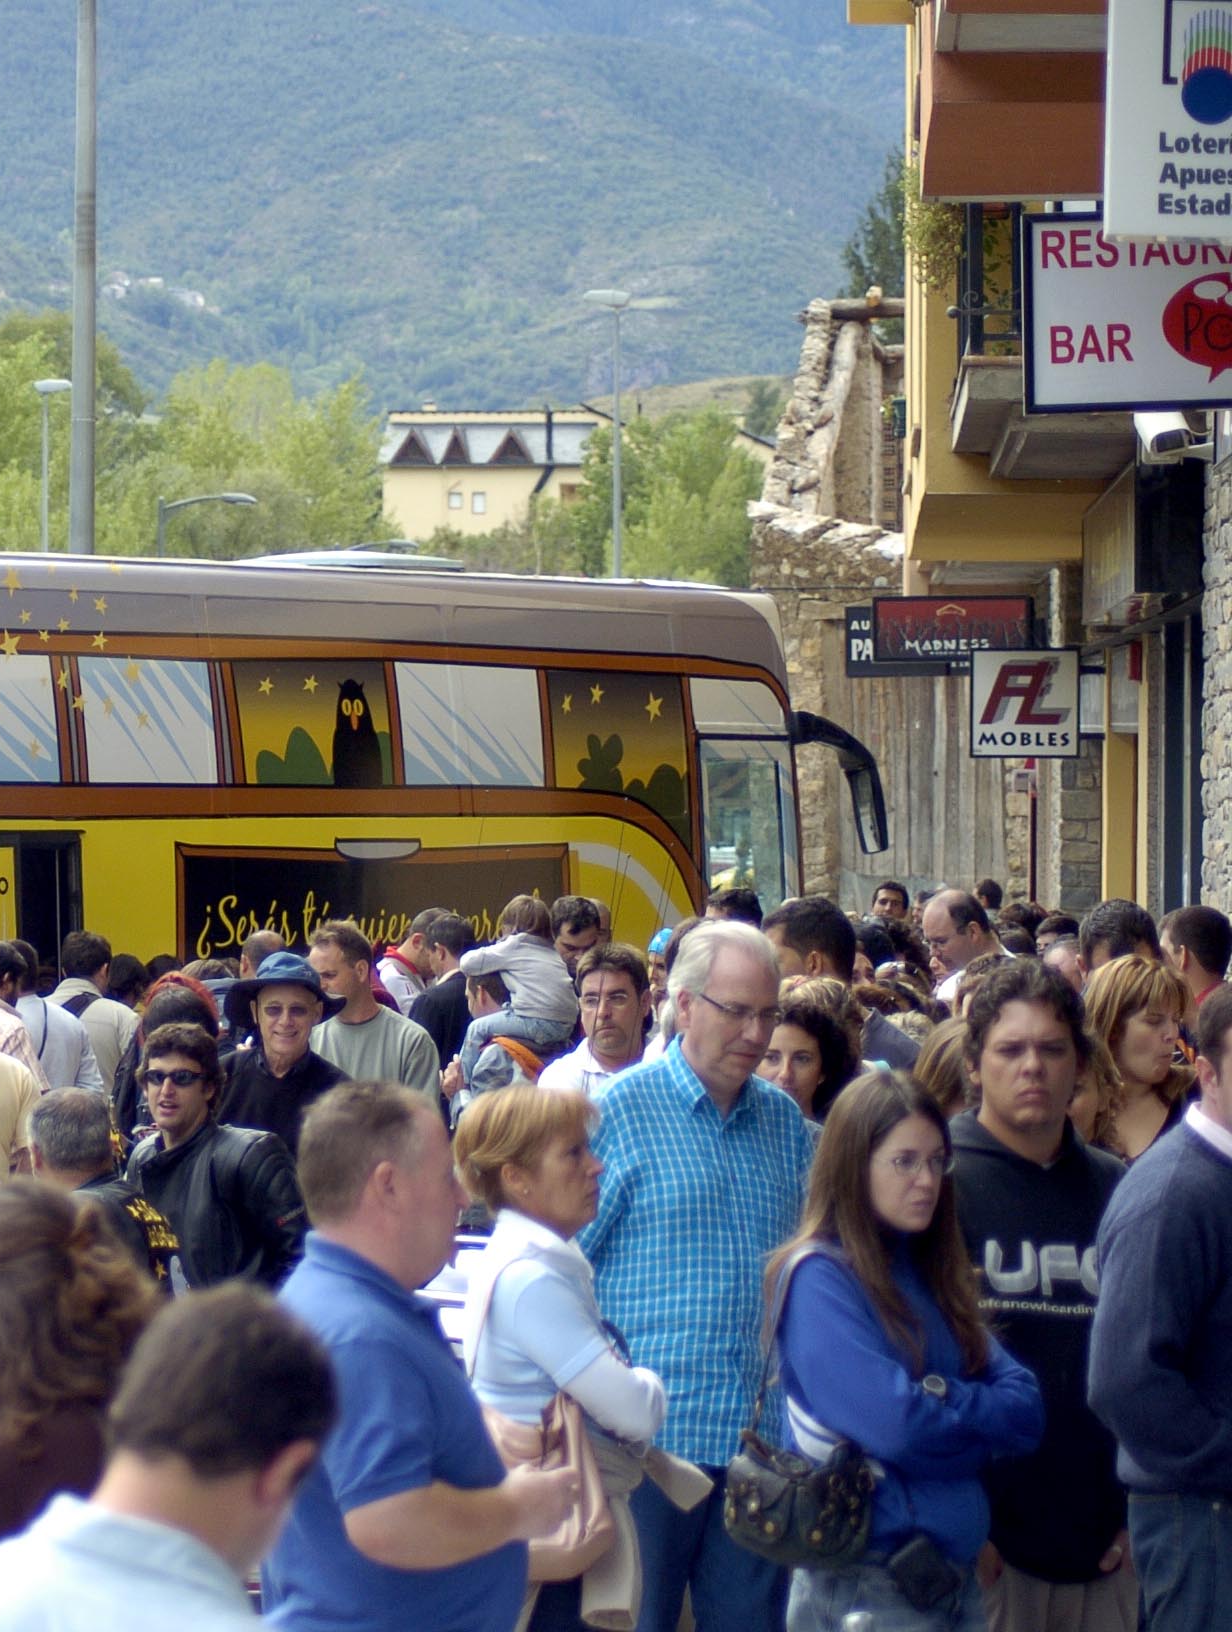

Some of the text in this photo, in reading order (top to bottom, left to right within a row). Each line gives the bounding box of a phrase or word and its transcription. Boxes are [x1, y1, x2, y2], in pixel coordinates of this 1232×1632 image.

[1049, 323, 1134, 365] BAR
[905, 638, 990, 656] MADNESS
[978, 731, 1070, 747] MOBLES
